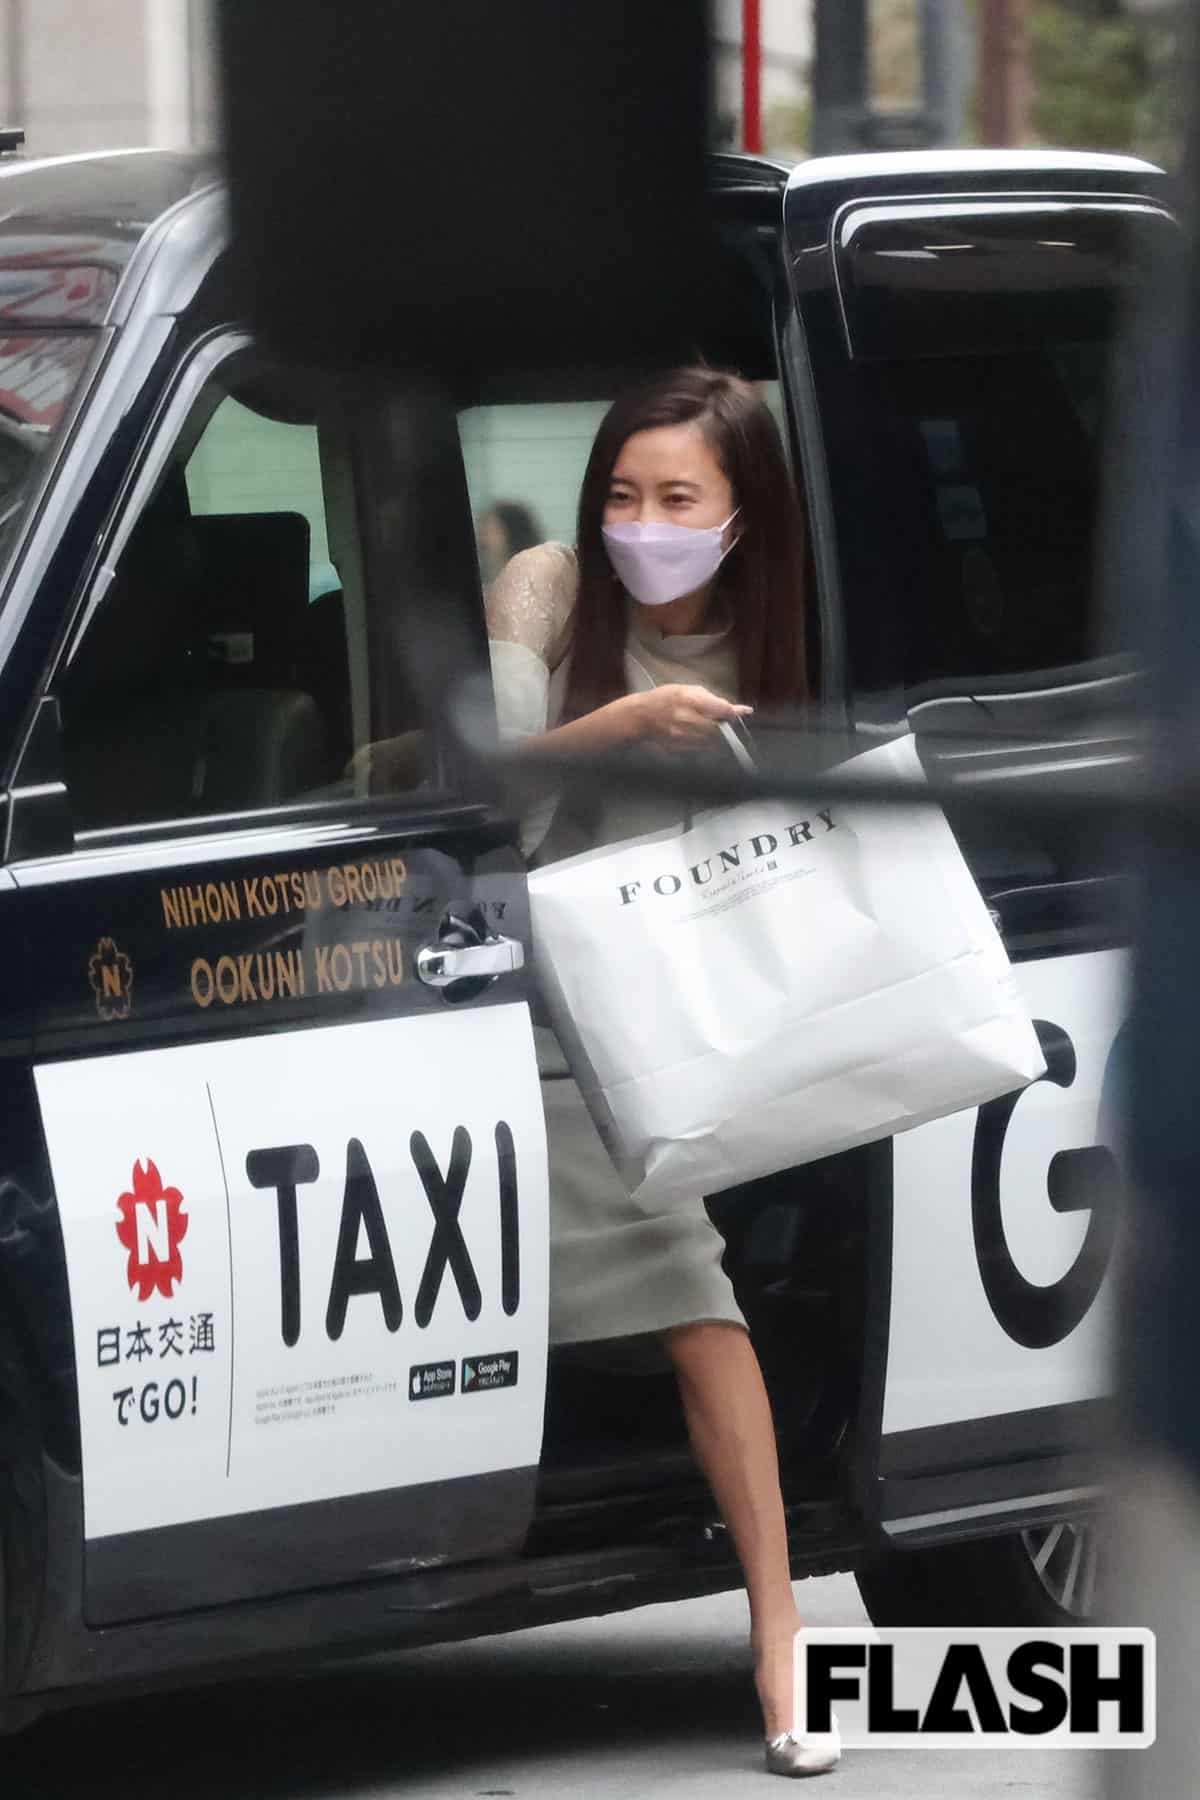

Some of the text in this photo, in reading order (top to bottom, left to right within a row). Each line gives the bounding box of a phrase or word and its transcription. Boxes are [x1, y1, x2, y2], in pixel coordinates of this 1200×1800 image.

[618, 808, 837, 906] FOUNDRY
[160, 879, 242, 929] NIHON
[246, 868, 321, 921] KOTSU
[327, 858, 407, 907] GROUP
[101, 963, 121, 997] N
[190, 937, 404, 1008] OOKUNI KOTSU
[134, 1199, 171, 1265] N
[245, 1120, 520, 1348] TAXI
[97, 1312, 215, 1367] 日本交通
[478, 1359, 511, 1376] Google Play
[112, 1375, 198, 1426] でGO!
